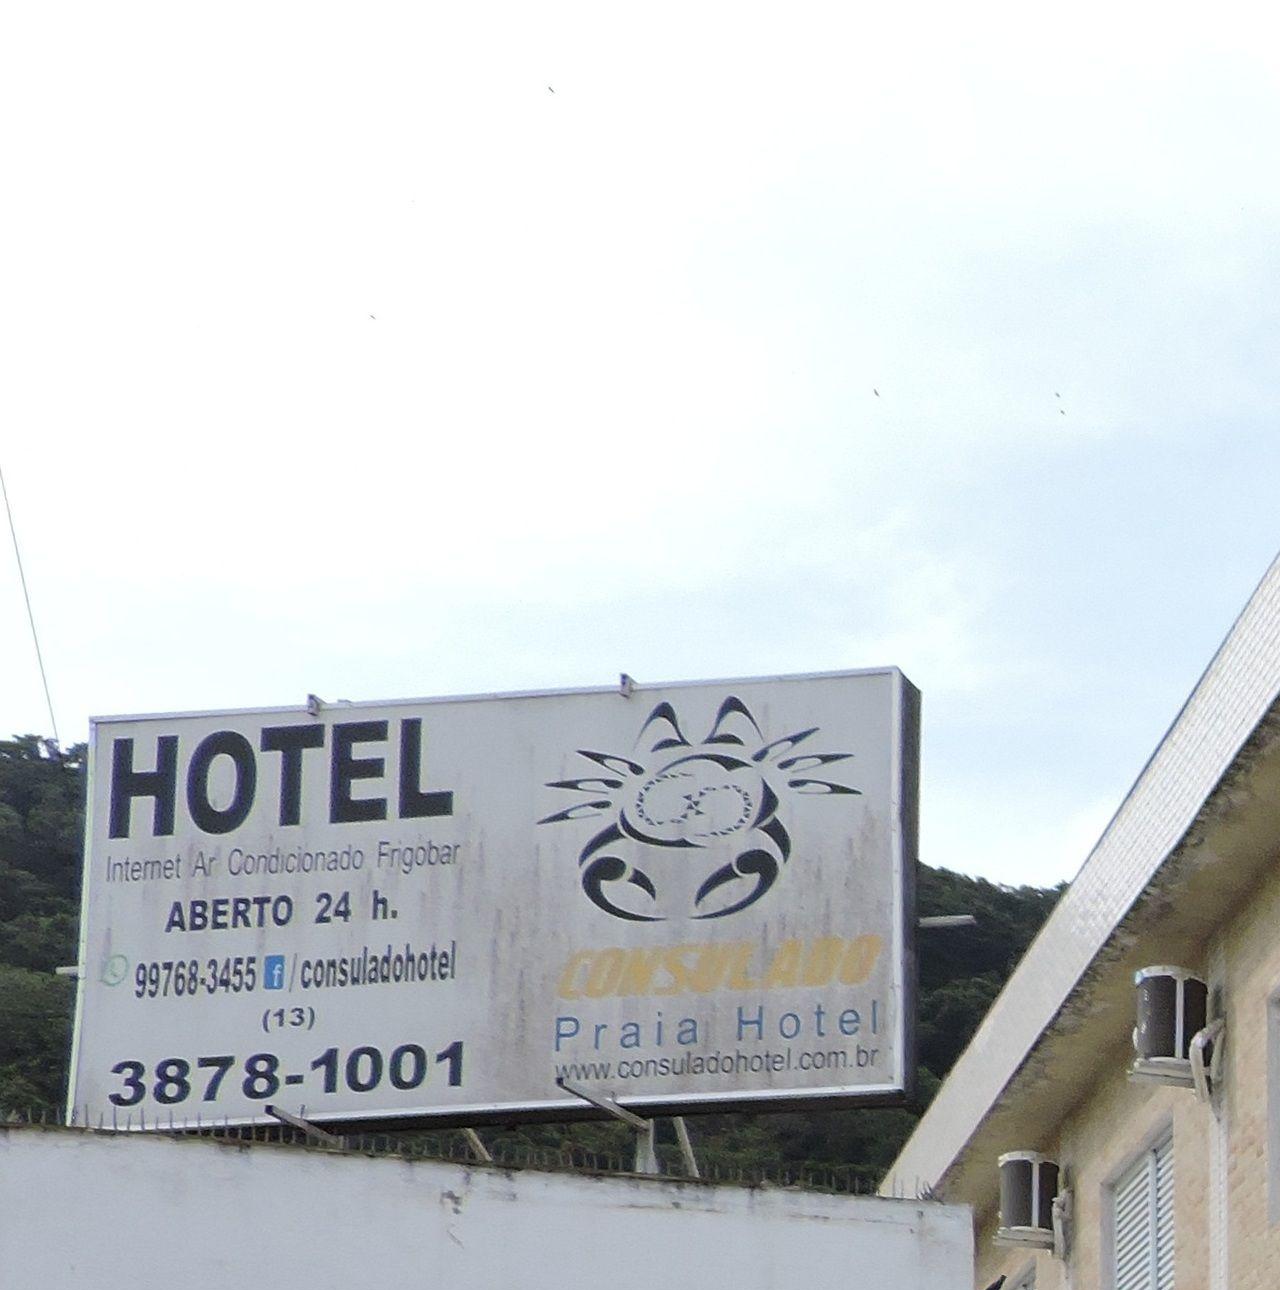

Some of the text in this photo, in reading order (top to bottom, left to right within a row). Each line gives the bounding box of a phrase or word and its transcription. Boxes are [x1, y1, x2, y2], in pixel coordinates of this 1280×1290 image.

[109, 718, 453, 838] HOTEL
[106, 840, 461, 882] Internet Ar Condicionado Frigobar
[165, 889, 399, 933] ABERTO 24 h.
[135, 956, 257, 998] 99768-3455
[556, 934, 884, 1000] CONSULADO
[262, 1006, 316, 1033] (13)
[555, 1000, 879, 1052] Praia Hotel
[108, 1041, 464, 1107] 3878-1001
[554, 1045, 879, 1081] www.consuladohotel.com.br
